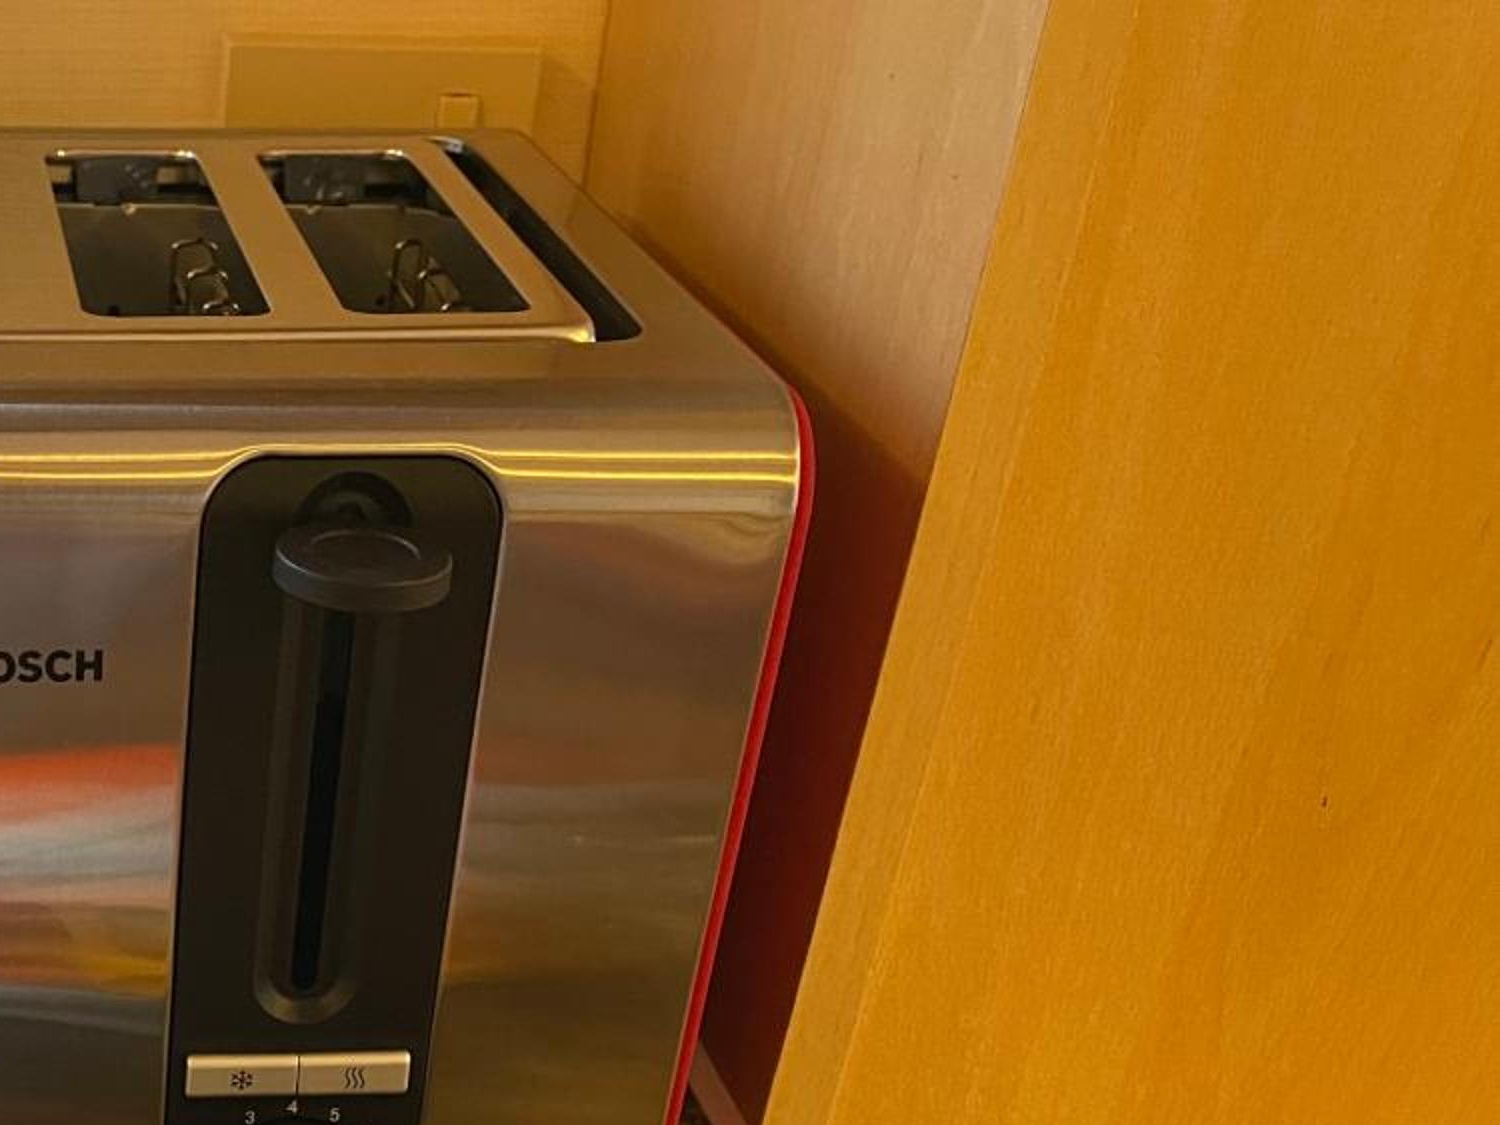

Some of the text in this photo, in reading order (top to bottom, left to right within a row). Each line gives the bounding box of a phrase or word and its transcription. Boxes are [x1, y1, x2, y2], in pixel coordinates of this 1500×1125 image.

[245, 1111, 256, 1125] 3
[286, 1100, 298, 1114] 4
[329, 1108, 341, 1122] 5
